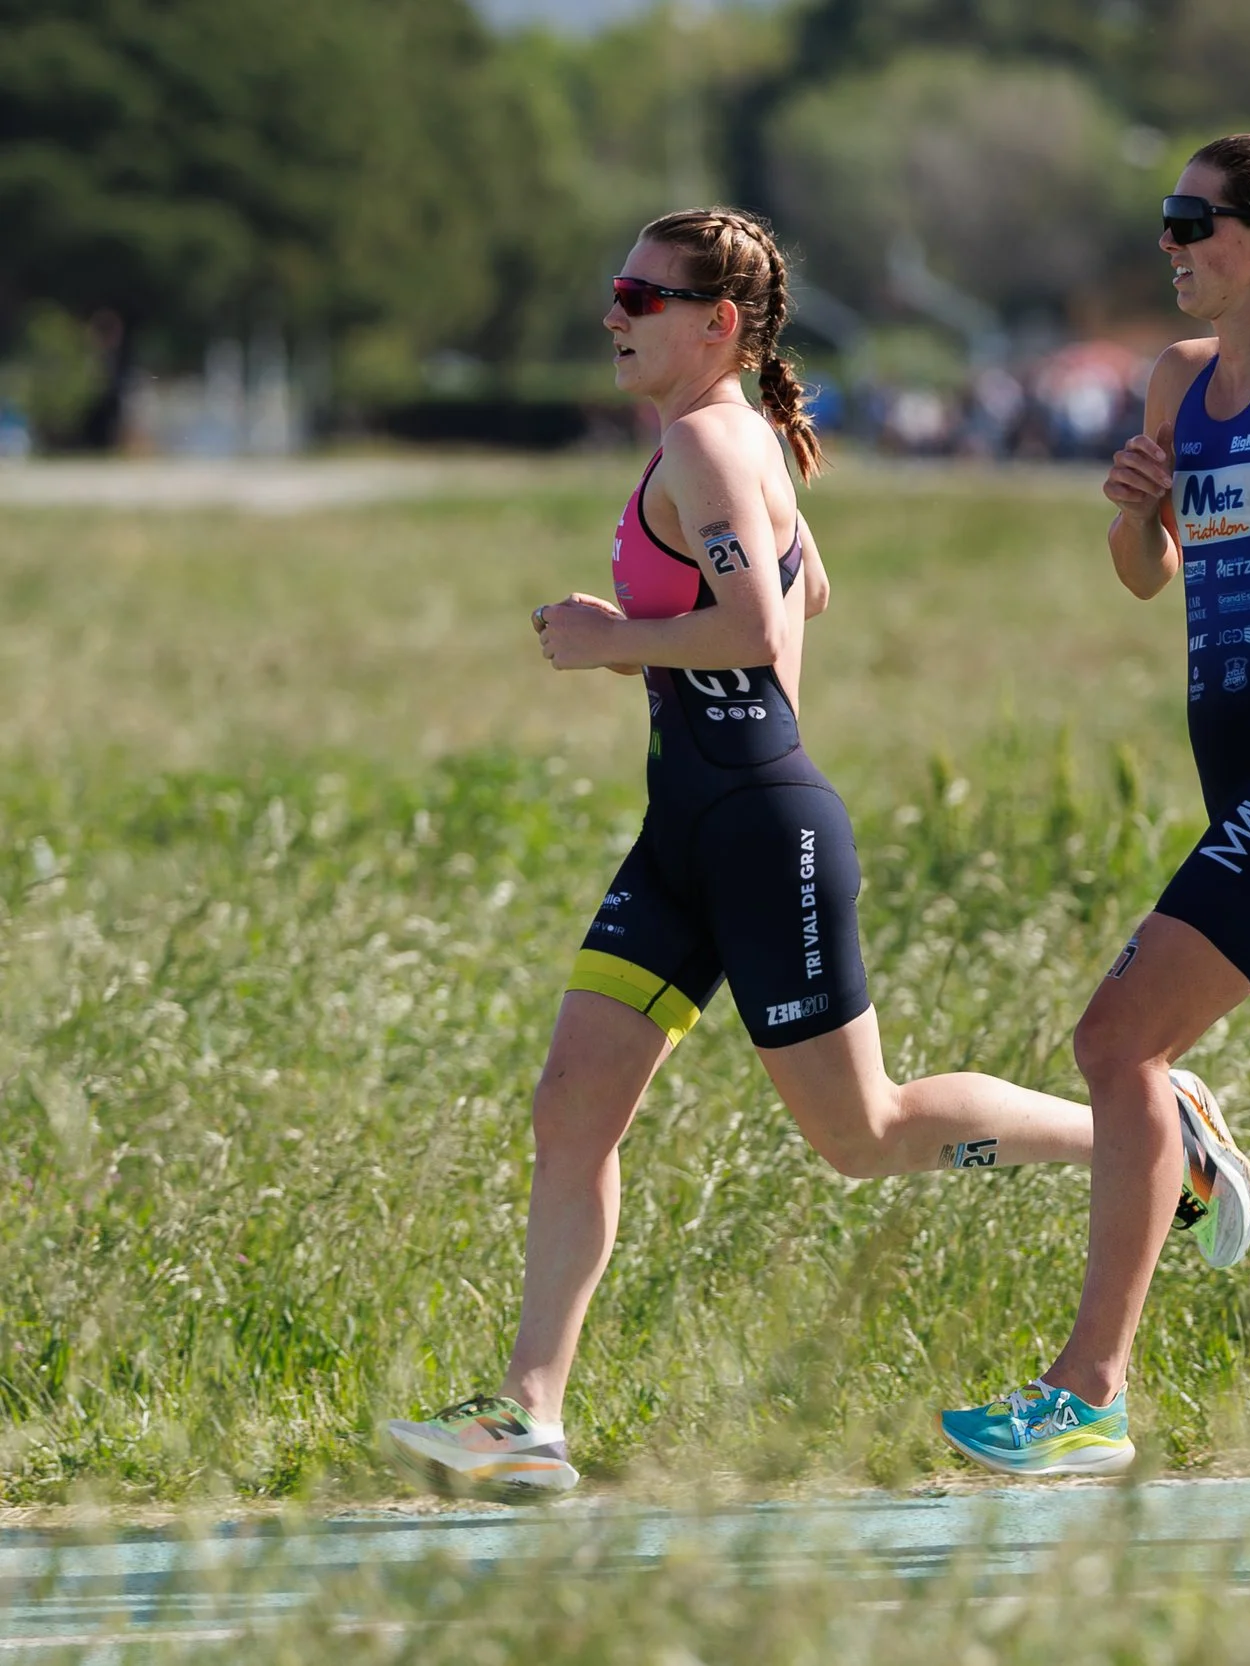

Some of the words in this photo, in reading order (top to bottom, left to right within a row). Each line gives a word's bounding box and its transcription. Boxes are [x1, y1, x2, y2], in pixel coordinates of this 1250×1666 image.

[1181, 474, 1244, 516] Metz
[1185, 516, 1249, 541] Triathlon
[707, 539, 751, 576] 21
[800, 828, 815, 879] GRAY
[801, 882, 816, 908] DE
[802, 910, 819, 949] VAL
[805, 950, 823, 979] TRI
[960, 1137, 999, 1168] 21
